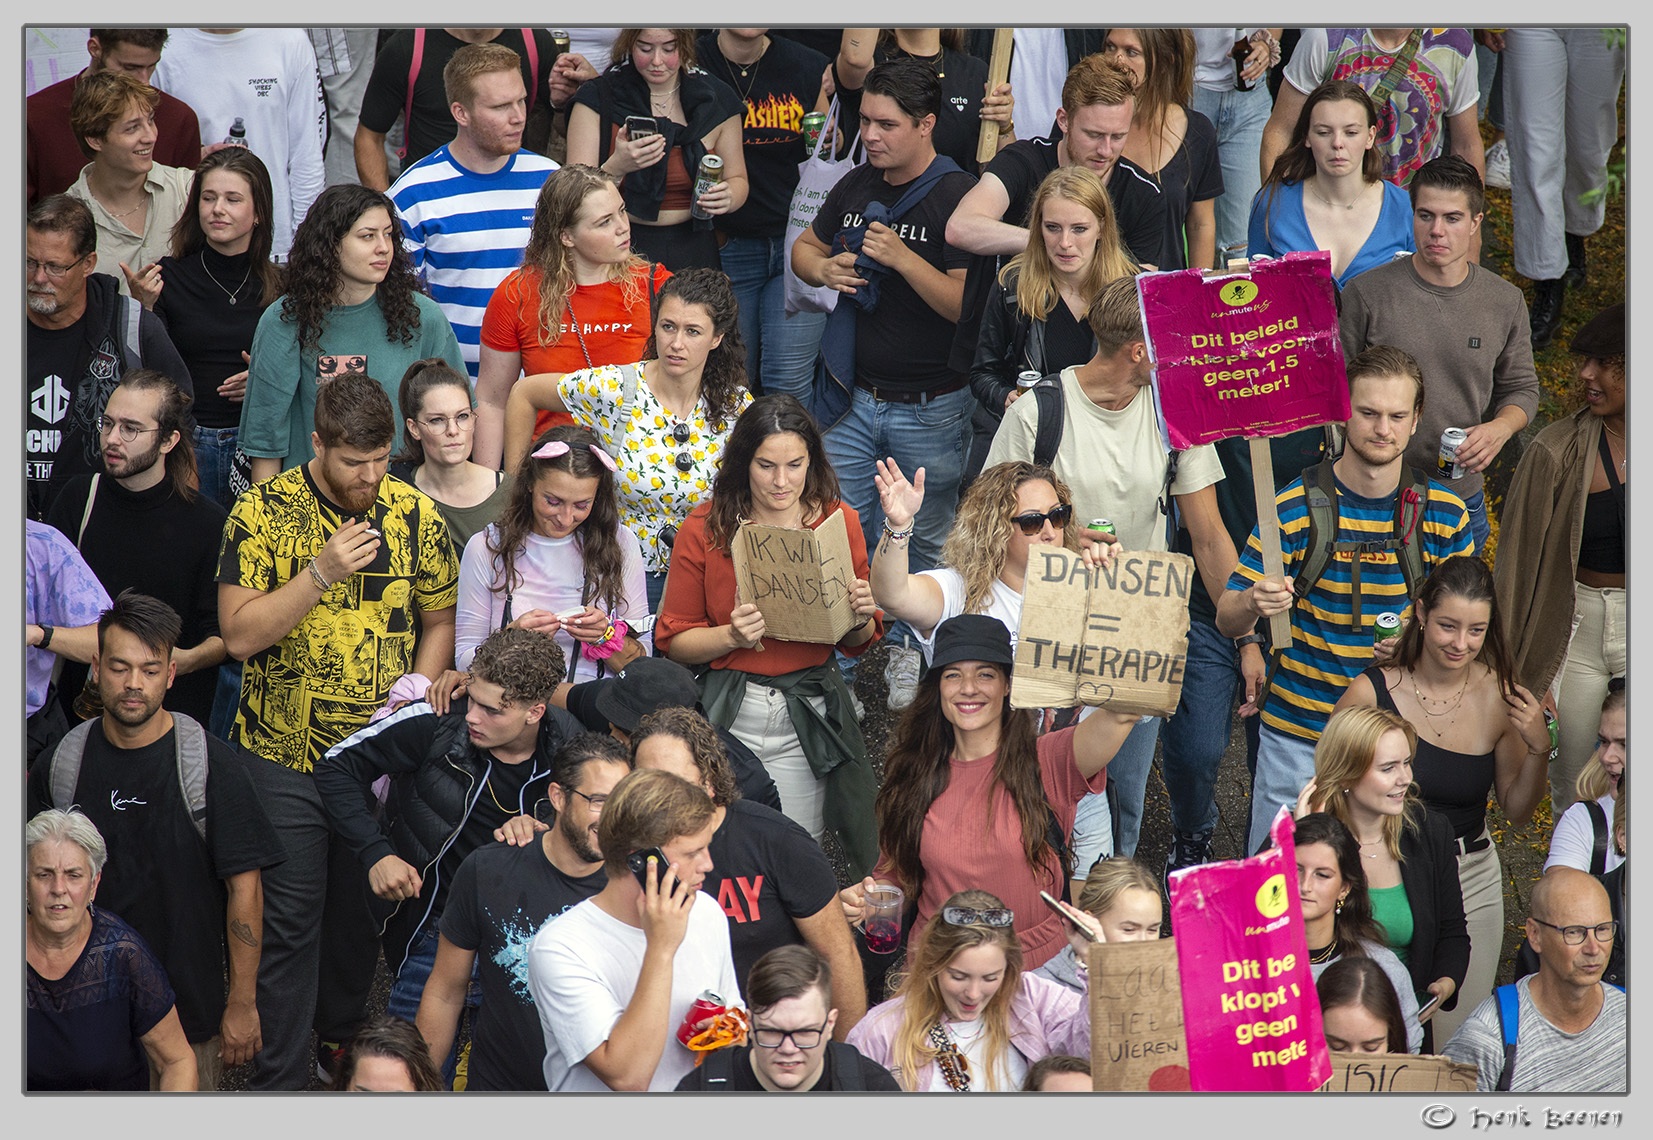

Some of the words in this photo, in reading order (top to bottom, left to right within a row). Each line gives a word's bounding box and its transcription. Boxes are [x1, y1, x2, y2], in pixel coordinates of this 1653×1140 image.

[950, 96, 968, 104] arte
[1191, 333, 1224, 348] Dit
[1230, 316, 1299, 346] beleid
[1254, 336, 1306, 358] voor
[1203, 367, 1260, 387] geen
[1267, 354, 1299, 372] 1.5
[1218, 375, 1290, 400] meter!
[748, 530, 776, 564] IK
[780, 537, 834, 566] WIL
[750, 566, 847, 608] DANSEN
[1040, 552, 1189, 599] DANSEN
[1026, 636, 1186, 685] THERAPIE
[717, 874, 764, 924] AY
[1222, 958, 1262, 983] Dit
[1220, 985, 1288, 1014] klopt
[1236, 1014, 1298, 1046] geen
